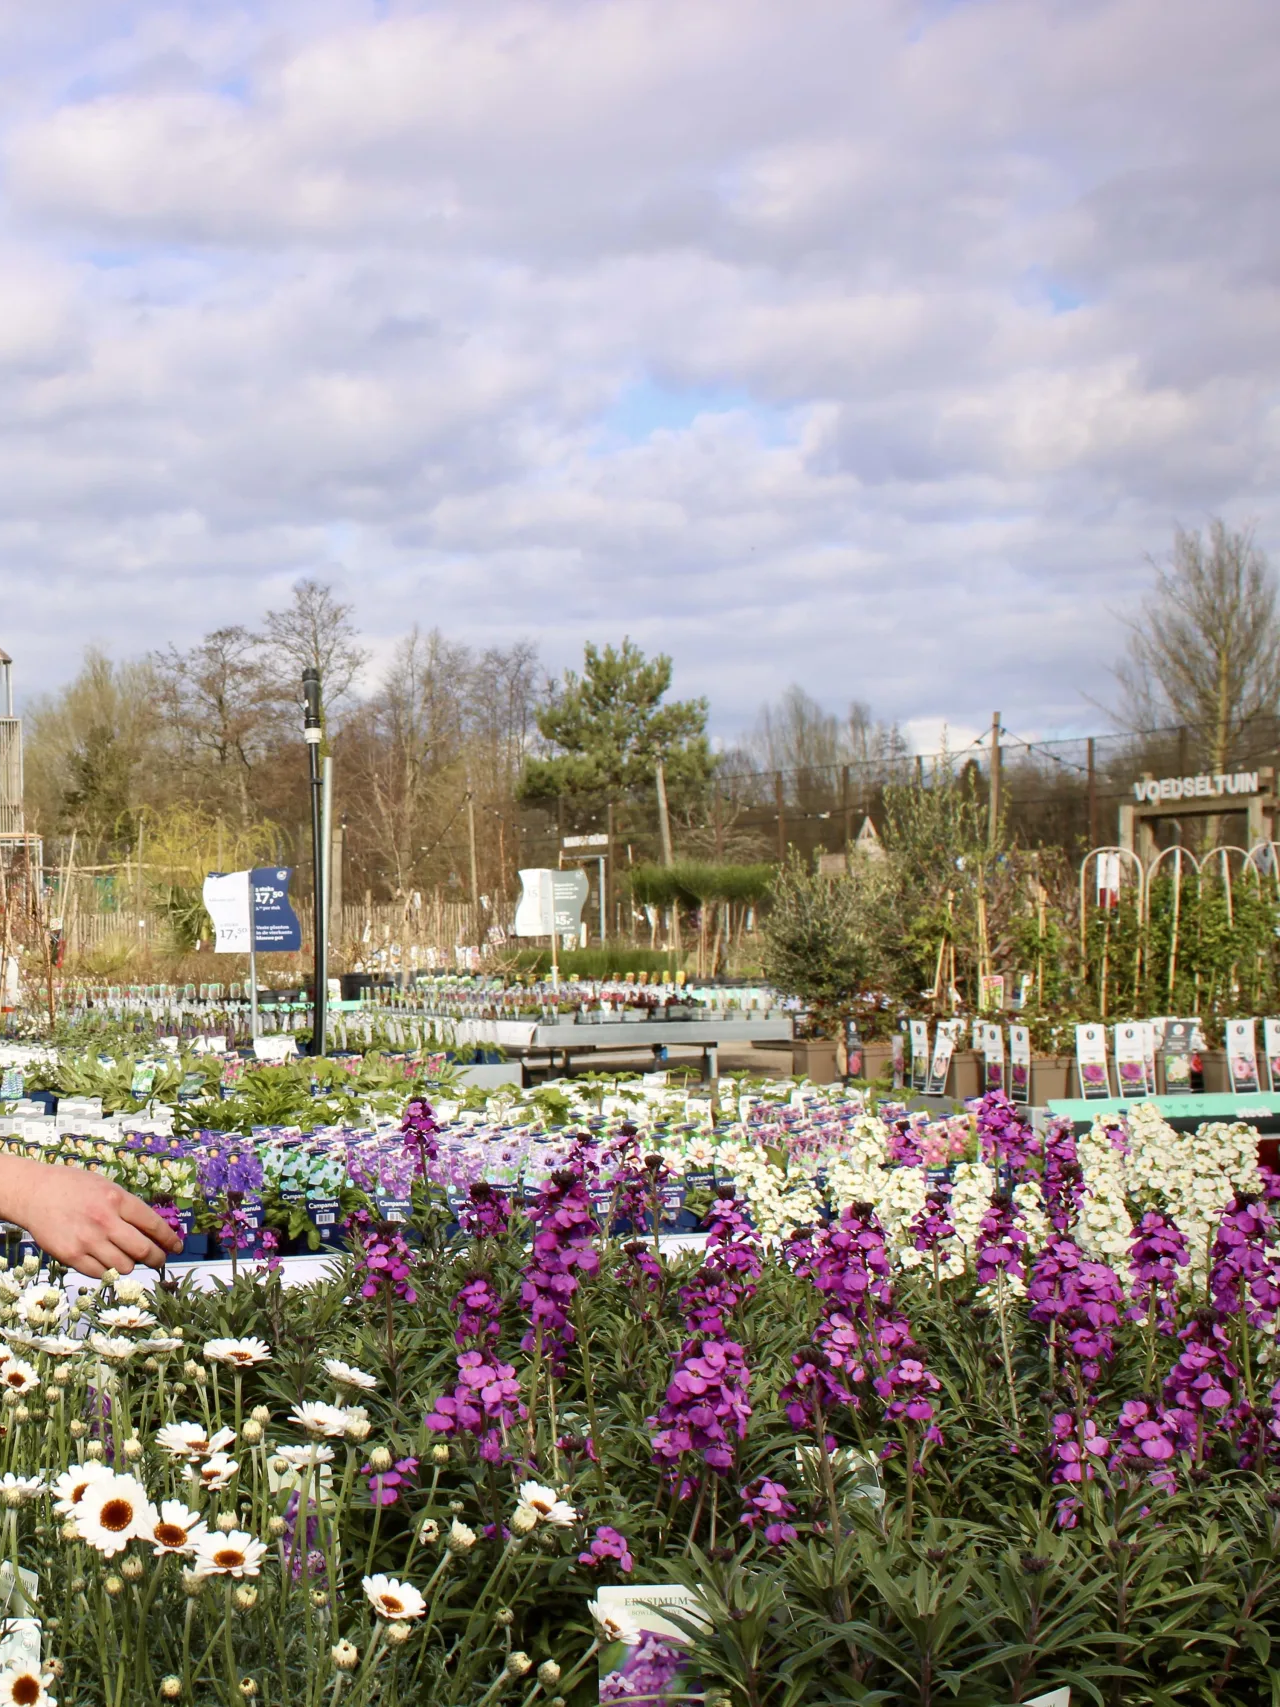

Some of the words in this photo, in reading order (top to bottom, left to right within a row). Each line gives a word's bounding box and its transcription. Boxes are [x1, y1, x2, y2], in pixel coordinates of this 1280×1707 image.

[1133, 772, 1259, 801] VOEDSELTUIN
[255, 891, 284, 905] 17,50
[308, 1201, 339, 1209] Campanula
